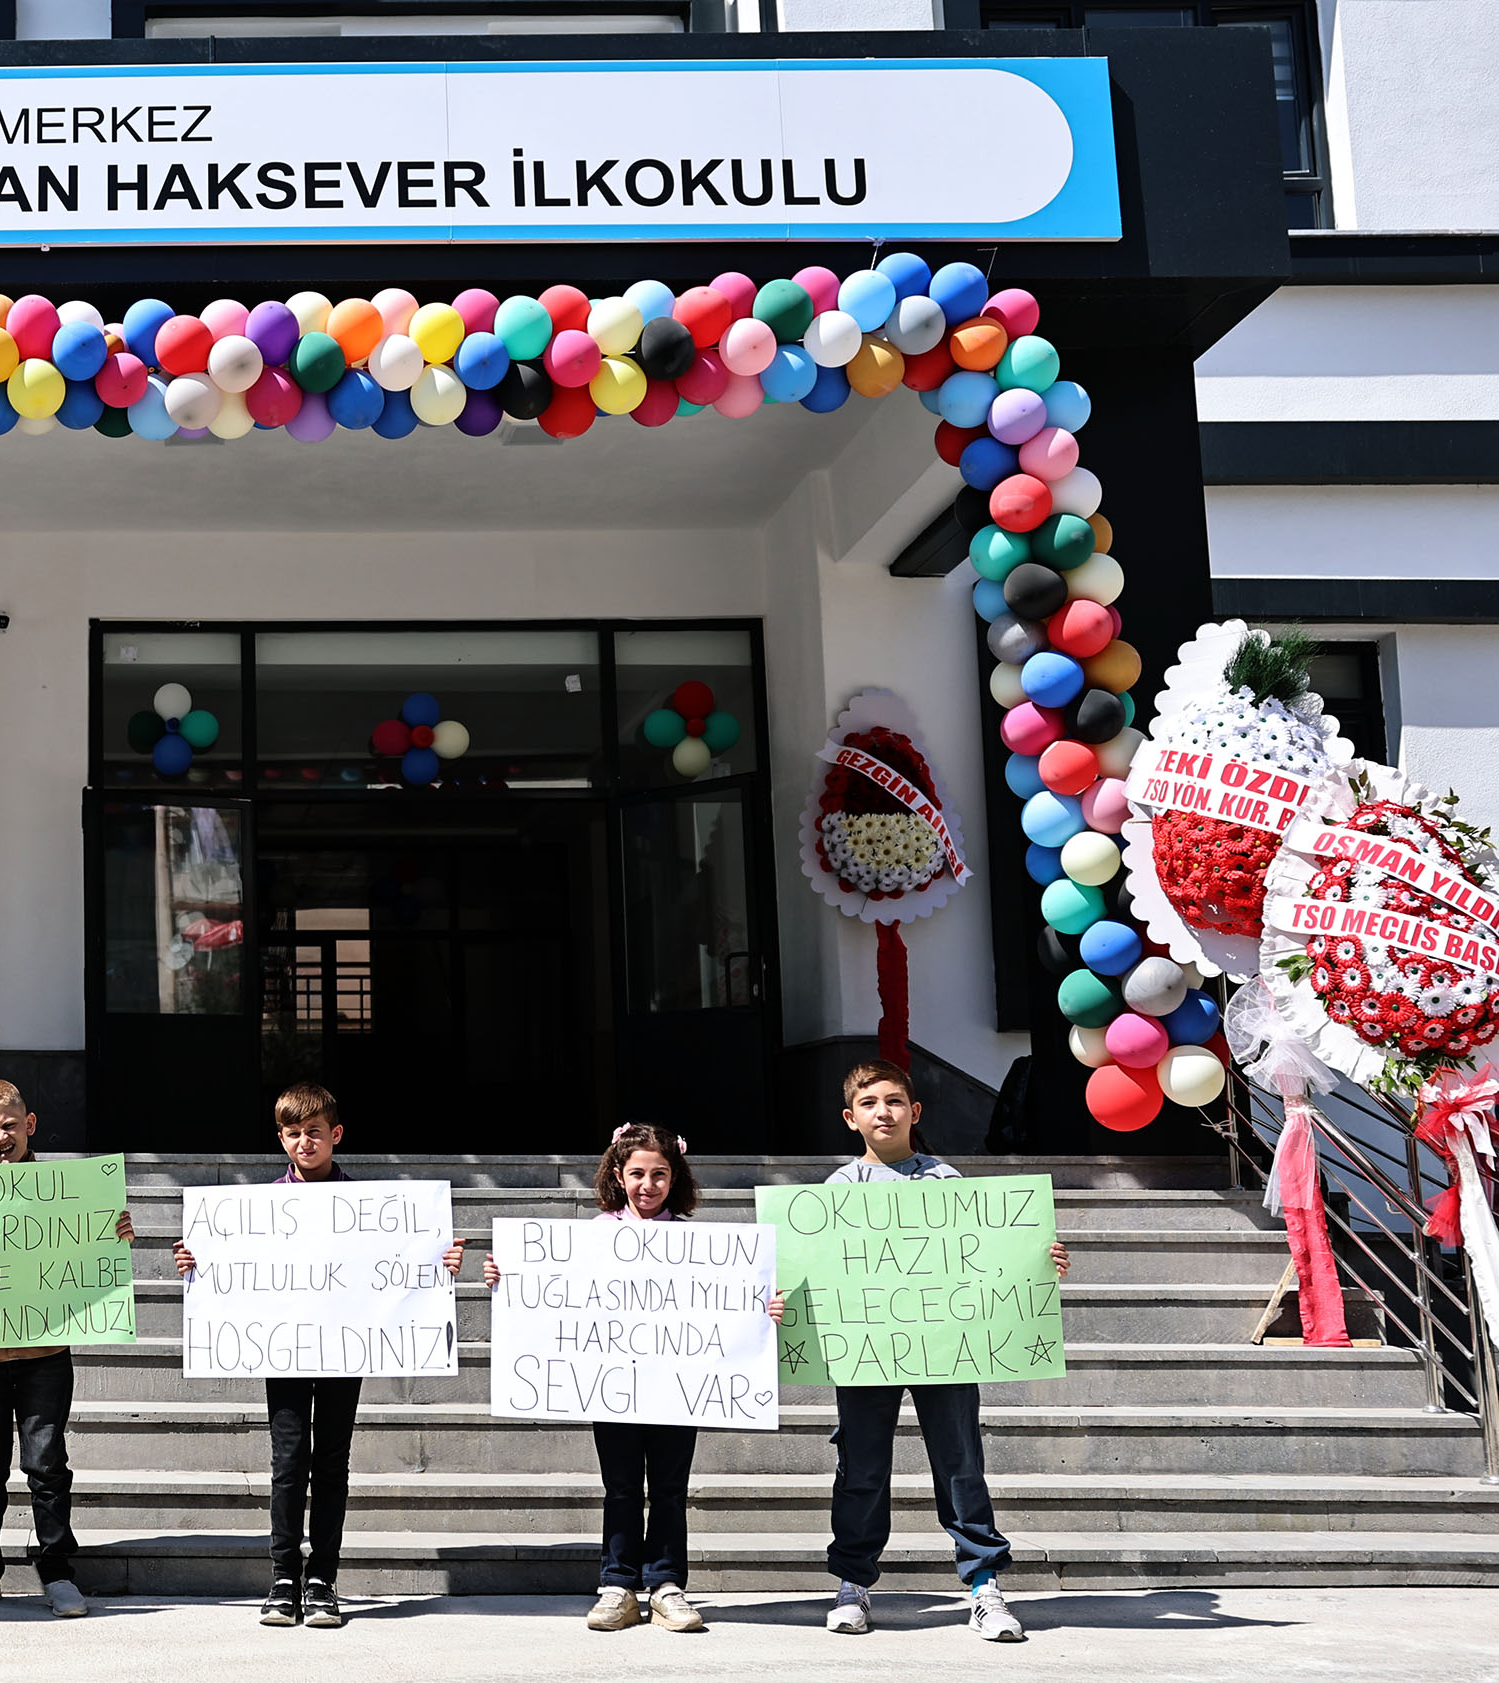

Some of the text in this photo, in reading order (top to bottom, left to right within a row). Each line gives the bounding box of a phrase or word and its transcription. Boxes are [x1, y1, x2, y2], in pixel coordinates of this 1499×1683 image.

[108, 160, 489, 211] HAKSEVER
[513, 148, 867, 207] İLKOKULU
[836, 749, 918, 805] GEZGİN
[1155, 749, 1213, 780] ZEKİ
[1142, 778, 1296, 831] TSO YÖN. KUR. B
[1312, 831, 1426, 883] OSMAN
[1292, 903, 1337, 930] TSO
[1340, 907, 1440, 951] MECLİS
[186, 1194, 442, 1241] AÇILIŞ DEĞİL,
[787, 1189, 1040, 1235] OKULUMUZ
[523, 1222, 759, 1266] BU OKULUN
[842, 1233, 1004, 1278] HAZIR,
[38, 1257, 130, 1290] KALBE
[186, 1262, 348, 1295] MUTLULUK
[555, 1319, 725, 1358] HARCINDA
[820, 1330, 1019, 1382] PARLAK
[510, 1354, 756, 1420] SEVGİ VAR
